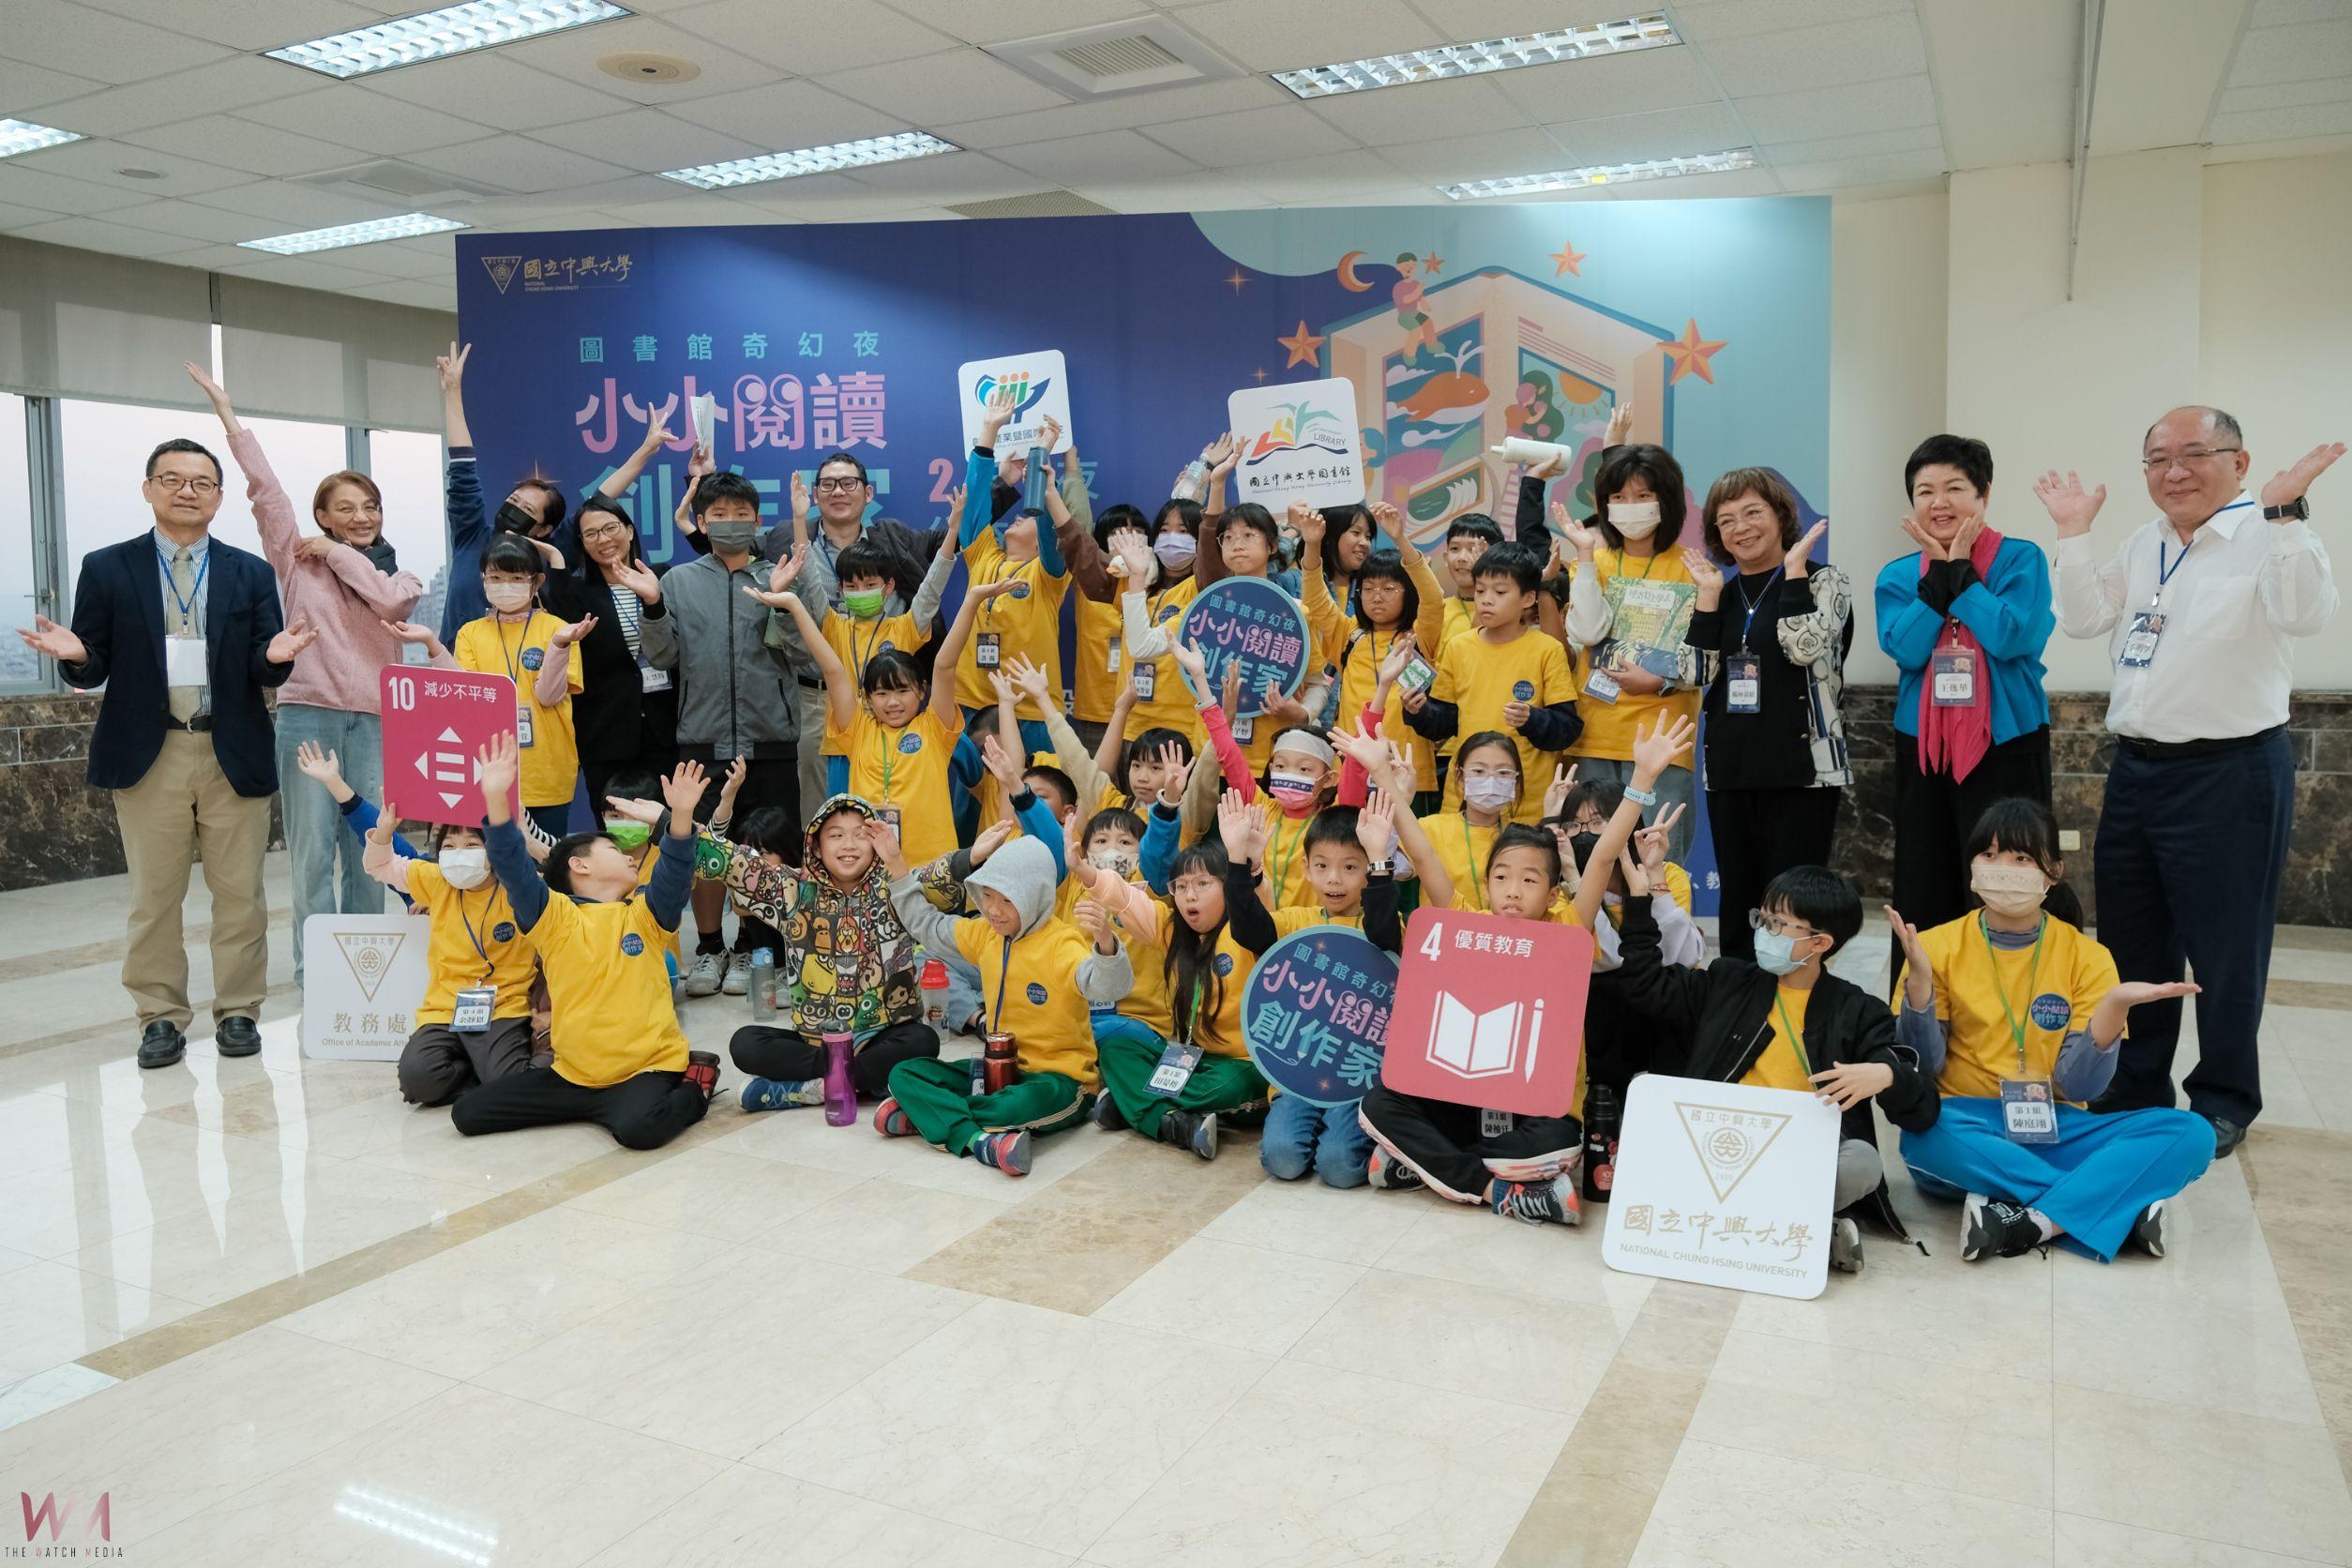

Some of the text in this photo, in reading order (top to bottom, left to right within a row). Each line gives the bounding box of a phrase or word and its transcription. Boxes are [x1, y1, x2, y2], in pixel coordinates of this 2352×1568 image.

[524, 254, 633, 283] 國立中興大學
[580, 330, 880, 364] 圖書館奇幻夜
[576, 371, 887, 453] 小小閱讀
[1314, 433, 1346, 445] LIBRARY
[1210, 595, 1296, 632] 圖書館奇幻夜
[1189, 610, 1302, 667] 小小閱讀
[388, 676, 415, 711] 10
[424, 681, 497, 703] 減少不平等
[1420, 922, 1443, 961] 4
[1455, 929, 1534, 958] 優質教育
[1294, 942, 1395, 1005] 圖書館奇幻
[334, 1012, 407, 1034] 教務處
[323, 1037, 344, 1047] Office
[345, 1038, 354, 1047] of
[355, 1038, 392, 1048] Academic
[1249, 1000, 1383, 1090] 創作家
[1691, 1109, 1772, 1130] 國立中興大學
[1623, 1204, 1814, 1262] 國立中興大學
[1621, 1244, 1808, 1279] NATIONAL CHUNG HSING UNIVERSITY
